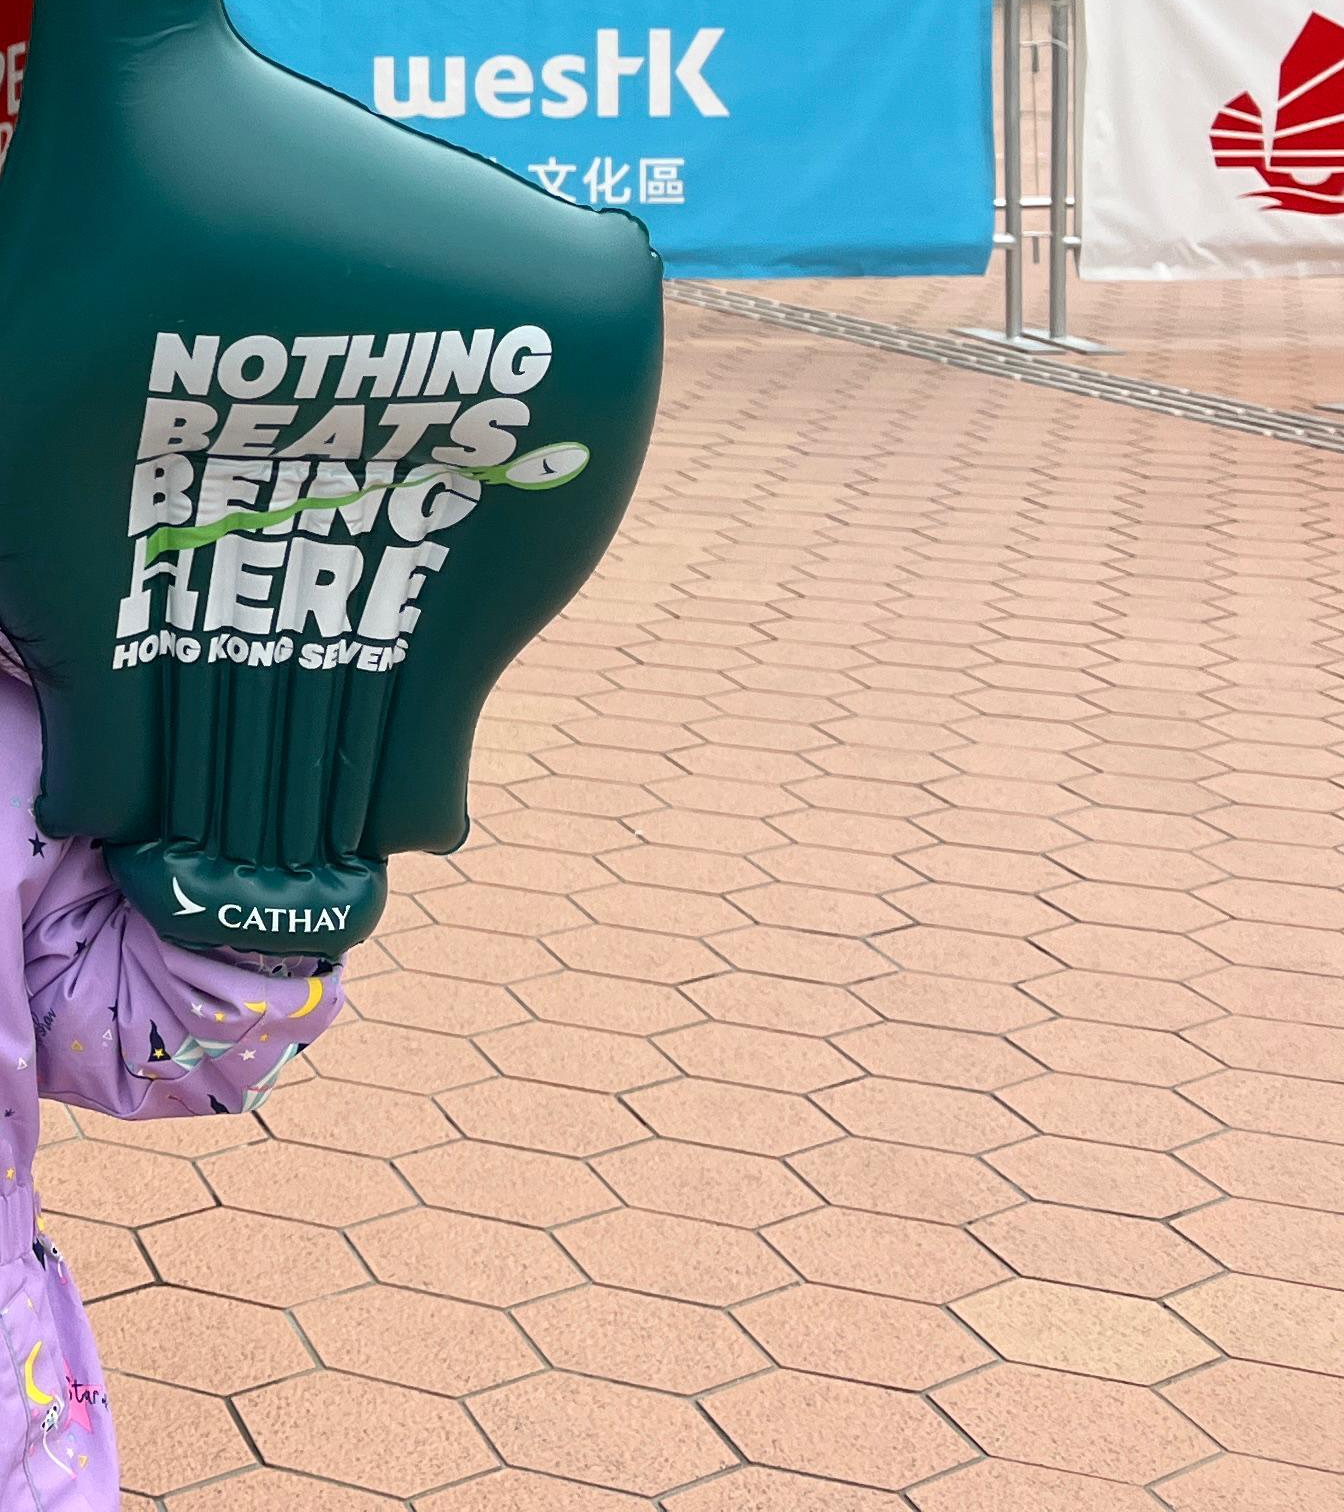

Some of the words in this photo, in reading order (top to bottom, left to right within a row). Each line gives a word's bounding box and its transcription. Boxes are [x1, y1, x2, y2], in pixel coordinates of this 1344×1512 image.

[489, 156, 685, 205] 文化區
[148, 324, 552, 400] NOTHING
[136, 397, 530, 467] BEATS
[127, 454, 485, 542] BEING
[116, 534, 450, 641] HERE
[112, 631, 201, 670] HONG
[207, 633, 295, 670] KONG
[298, 638, 410, 673] SEVENS
[217, 903, 352, 934] CATHAY
